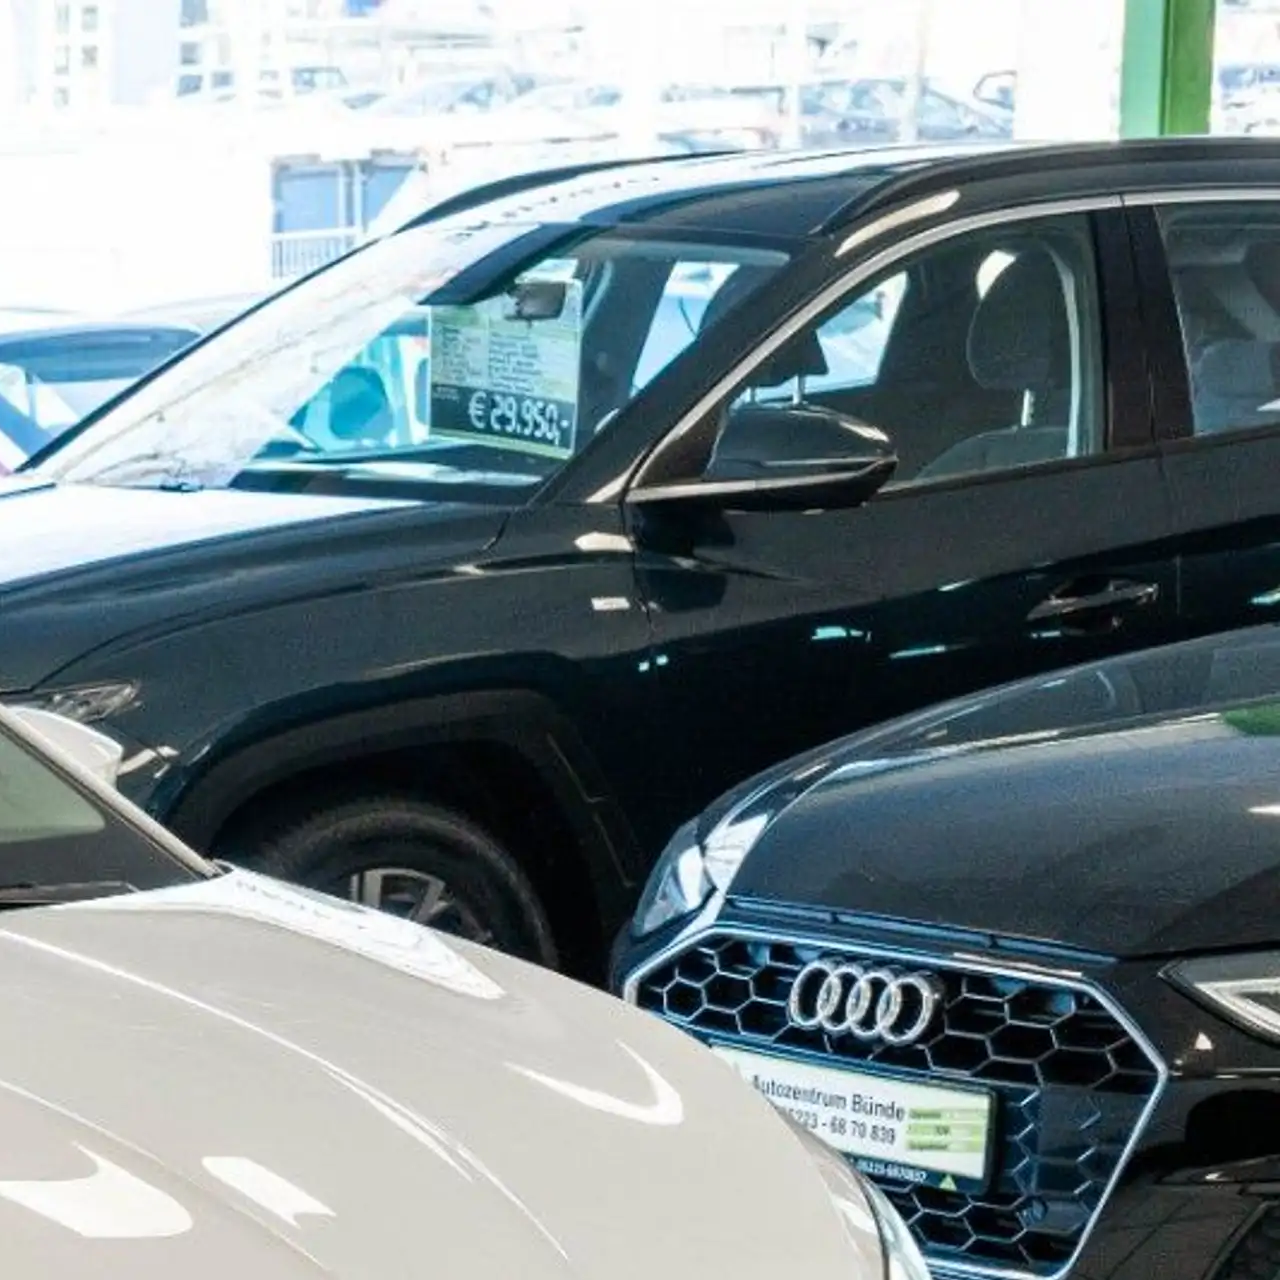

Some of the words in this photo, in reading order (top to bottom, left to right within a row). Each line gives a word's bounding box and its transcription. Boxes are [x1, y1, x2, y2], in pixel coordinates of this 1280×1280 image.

[752, 1074, 847, 1110] Autozentrum
[852, 1093, 906, 1122] Bünde
[851, 1119, 868, 1139] 70
